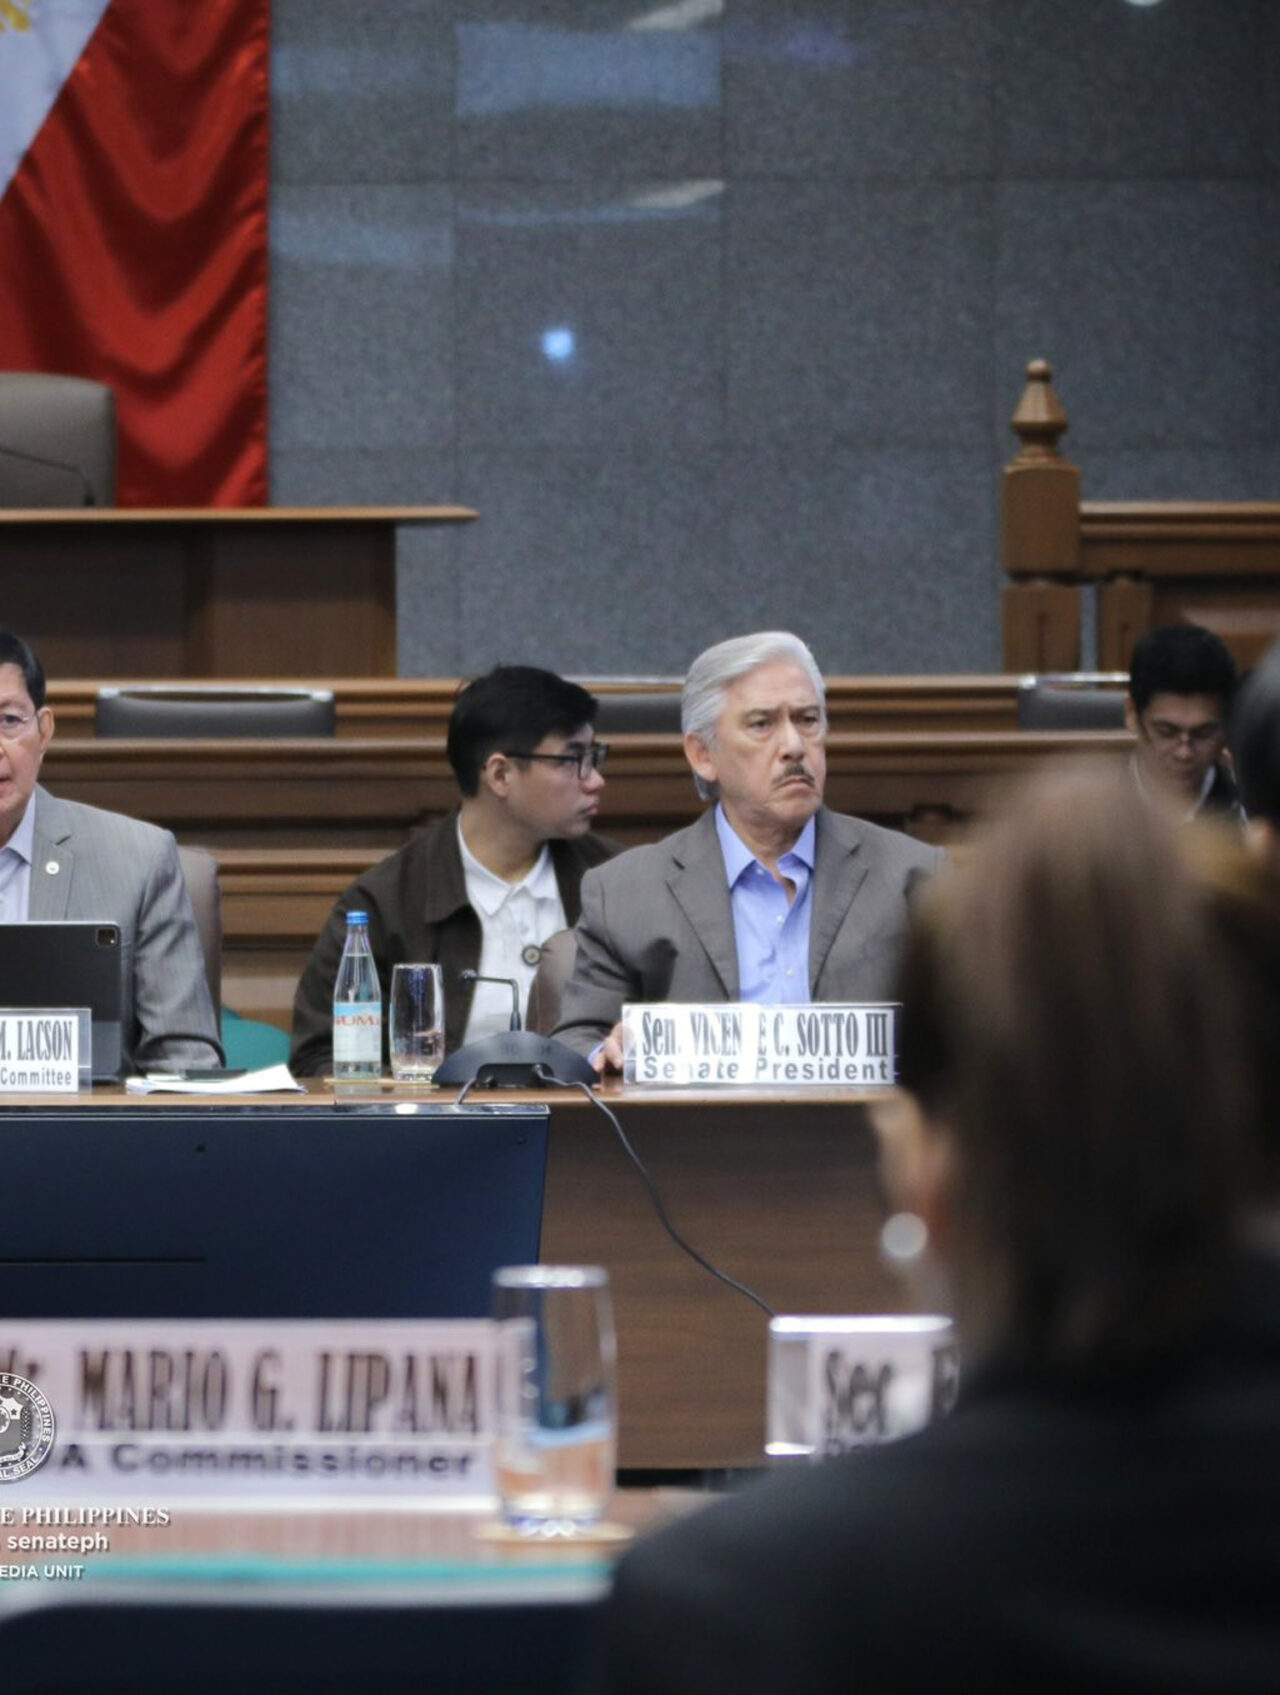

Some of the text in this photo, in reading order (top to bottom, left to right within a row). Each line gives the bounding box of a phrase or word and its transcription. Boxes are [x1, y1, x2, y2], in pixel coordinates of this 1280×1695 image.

[17, 1020, 72, 1060] LACSON
[642, 1011, 681, 1056] Sen.
[773, 1012, 790, 1056] C.
[797, 1012, 858, 1057] SOTTO
[865, 1013, 888, 1057] III
[1, 1067, 71, 1085] Committee
[756, 1057, 888, 1080] President
[78, 1349, 228, 1432] MARIO
[253, 1349, 295, 1432] G.
[318, 1351, 480, 1434] LIPANA
[113, 1443, 472, 1476] Commissioner
